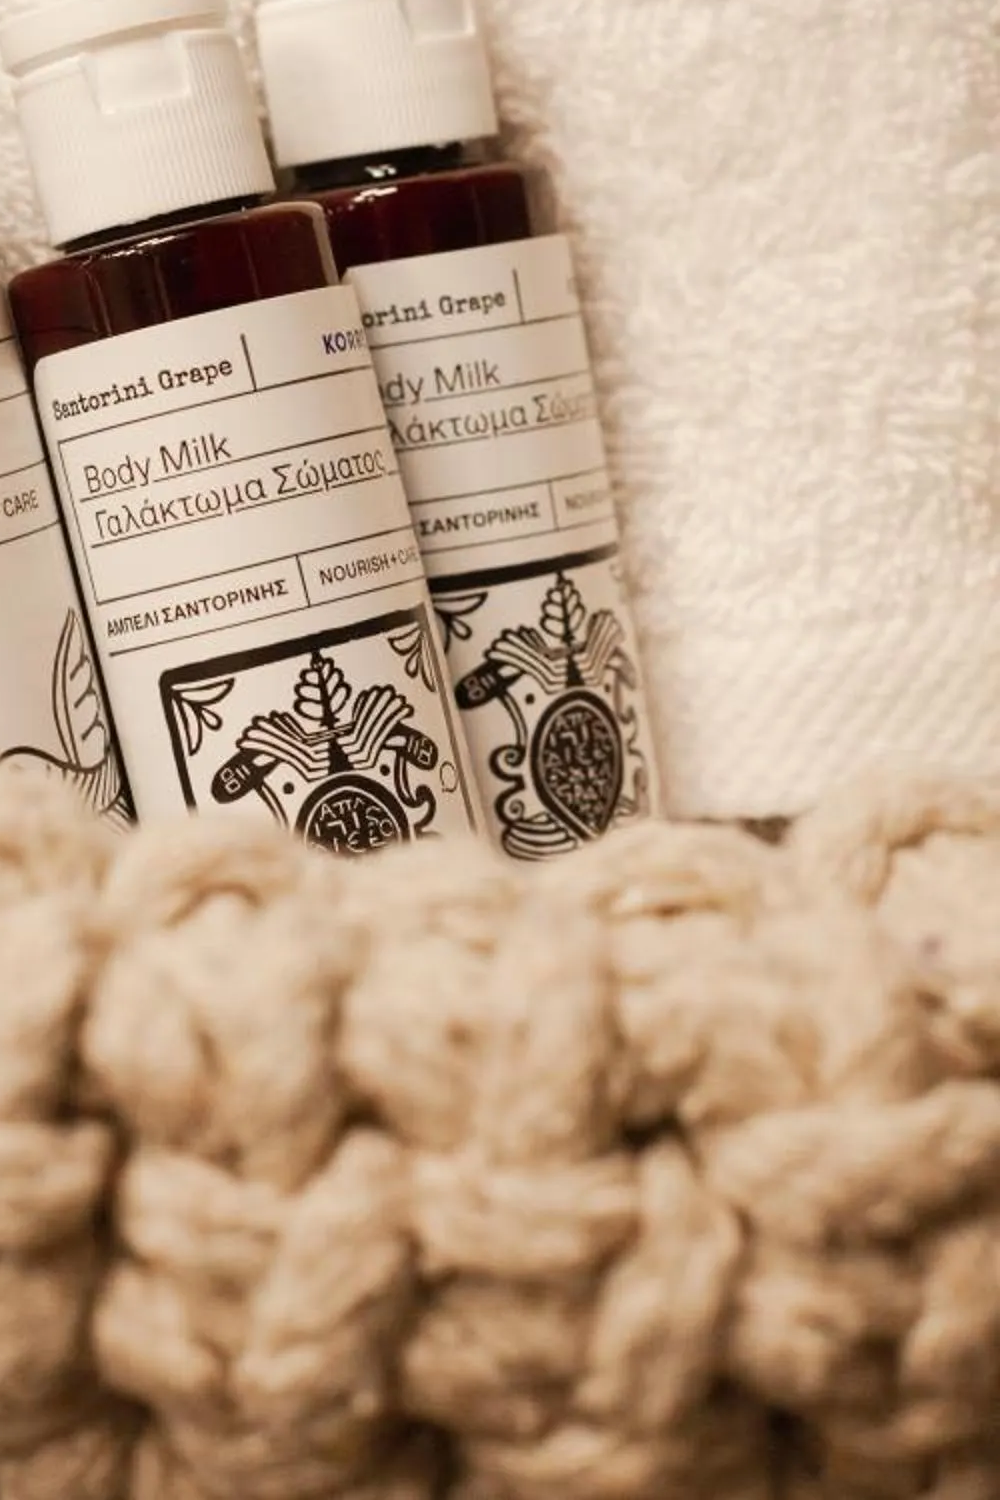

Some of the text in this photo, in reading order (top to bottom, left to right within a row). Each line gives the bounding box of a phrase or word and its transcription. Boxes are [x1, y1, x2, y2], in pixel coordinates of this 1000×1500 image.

[362, 290, 506, 328] orini Grape
[52, 359, 233, 421] Santorini Grape
[380, 359, 501, 405] dy Milk
[388, 403, 527, 445] λάκτωμα
[84, 432, 232, 494] Body Milk
[3, 489, 40, 517] CARE
[96, 448, 386, 539] Γαλάκτωμα Σώματος
[163, 579, 289, 624] ΣΑΝΤΟΡΙΝΗΣ
